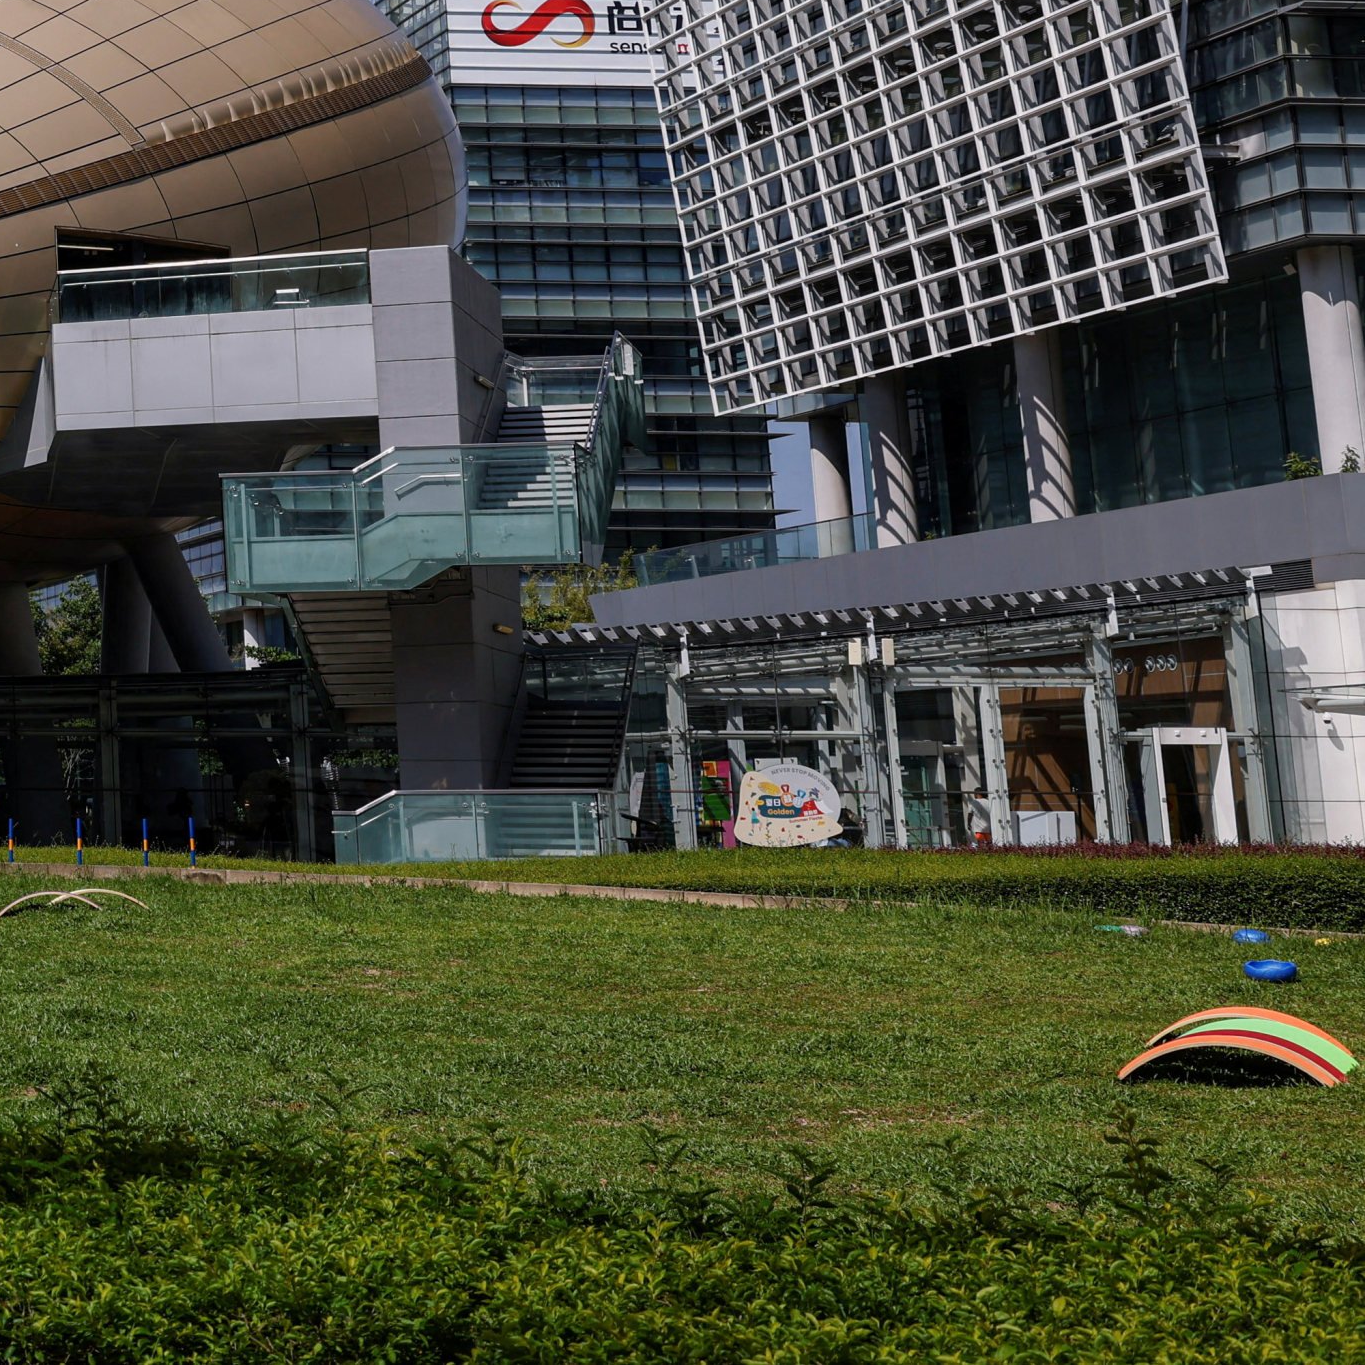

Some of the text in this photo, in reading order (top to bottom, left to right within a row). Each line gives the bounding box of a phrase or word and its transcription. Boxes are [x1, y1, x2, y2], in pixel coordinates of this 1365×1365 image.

[771, 767, 830, 791] NEVER STOP MOVING
